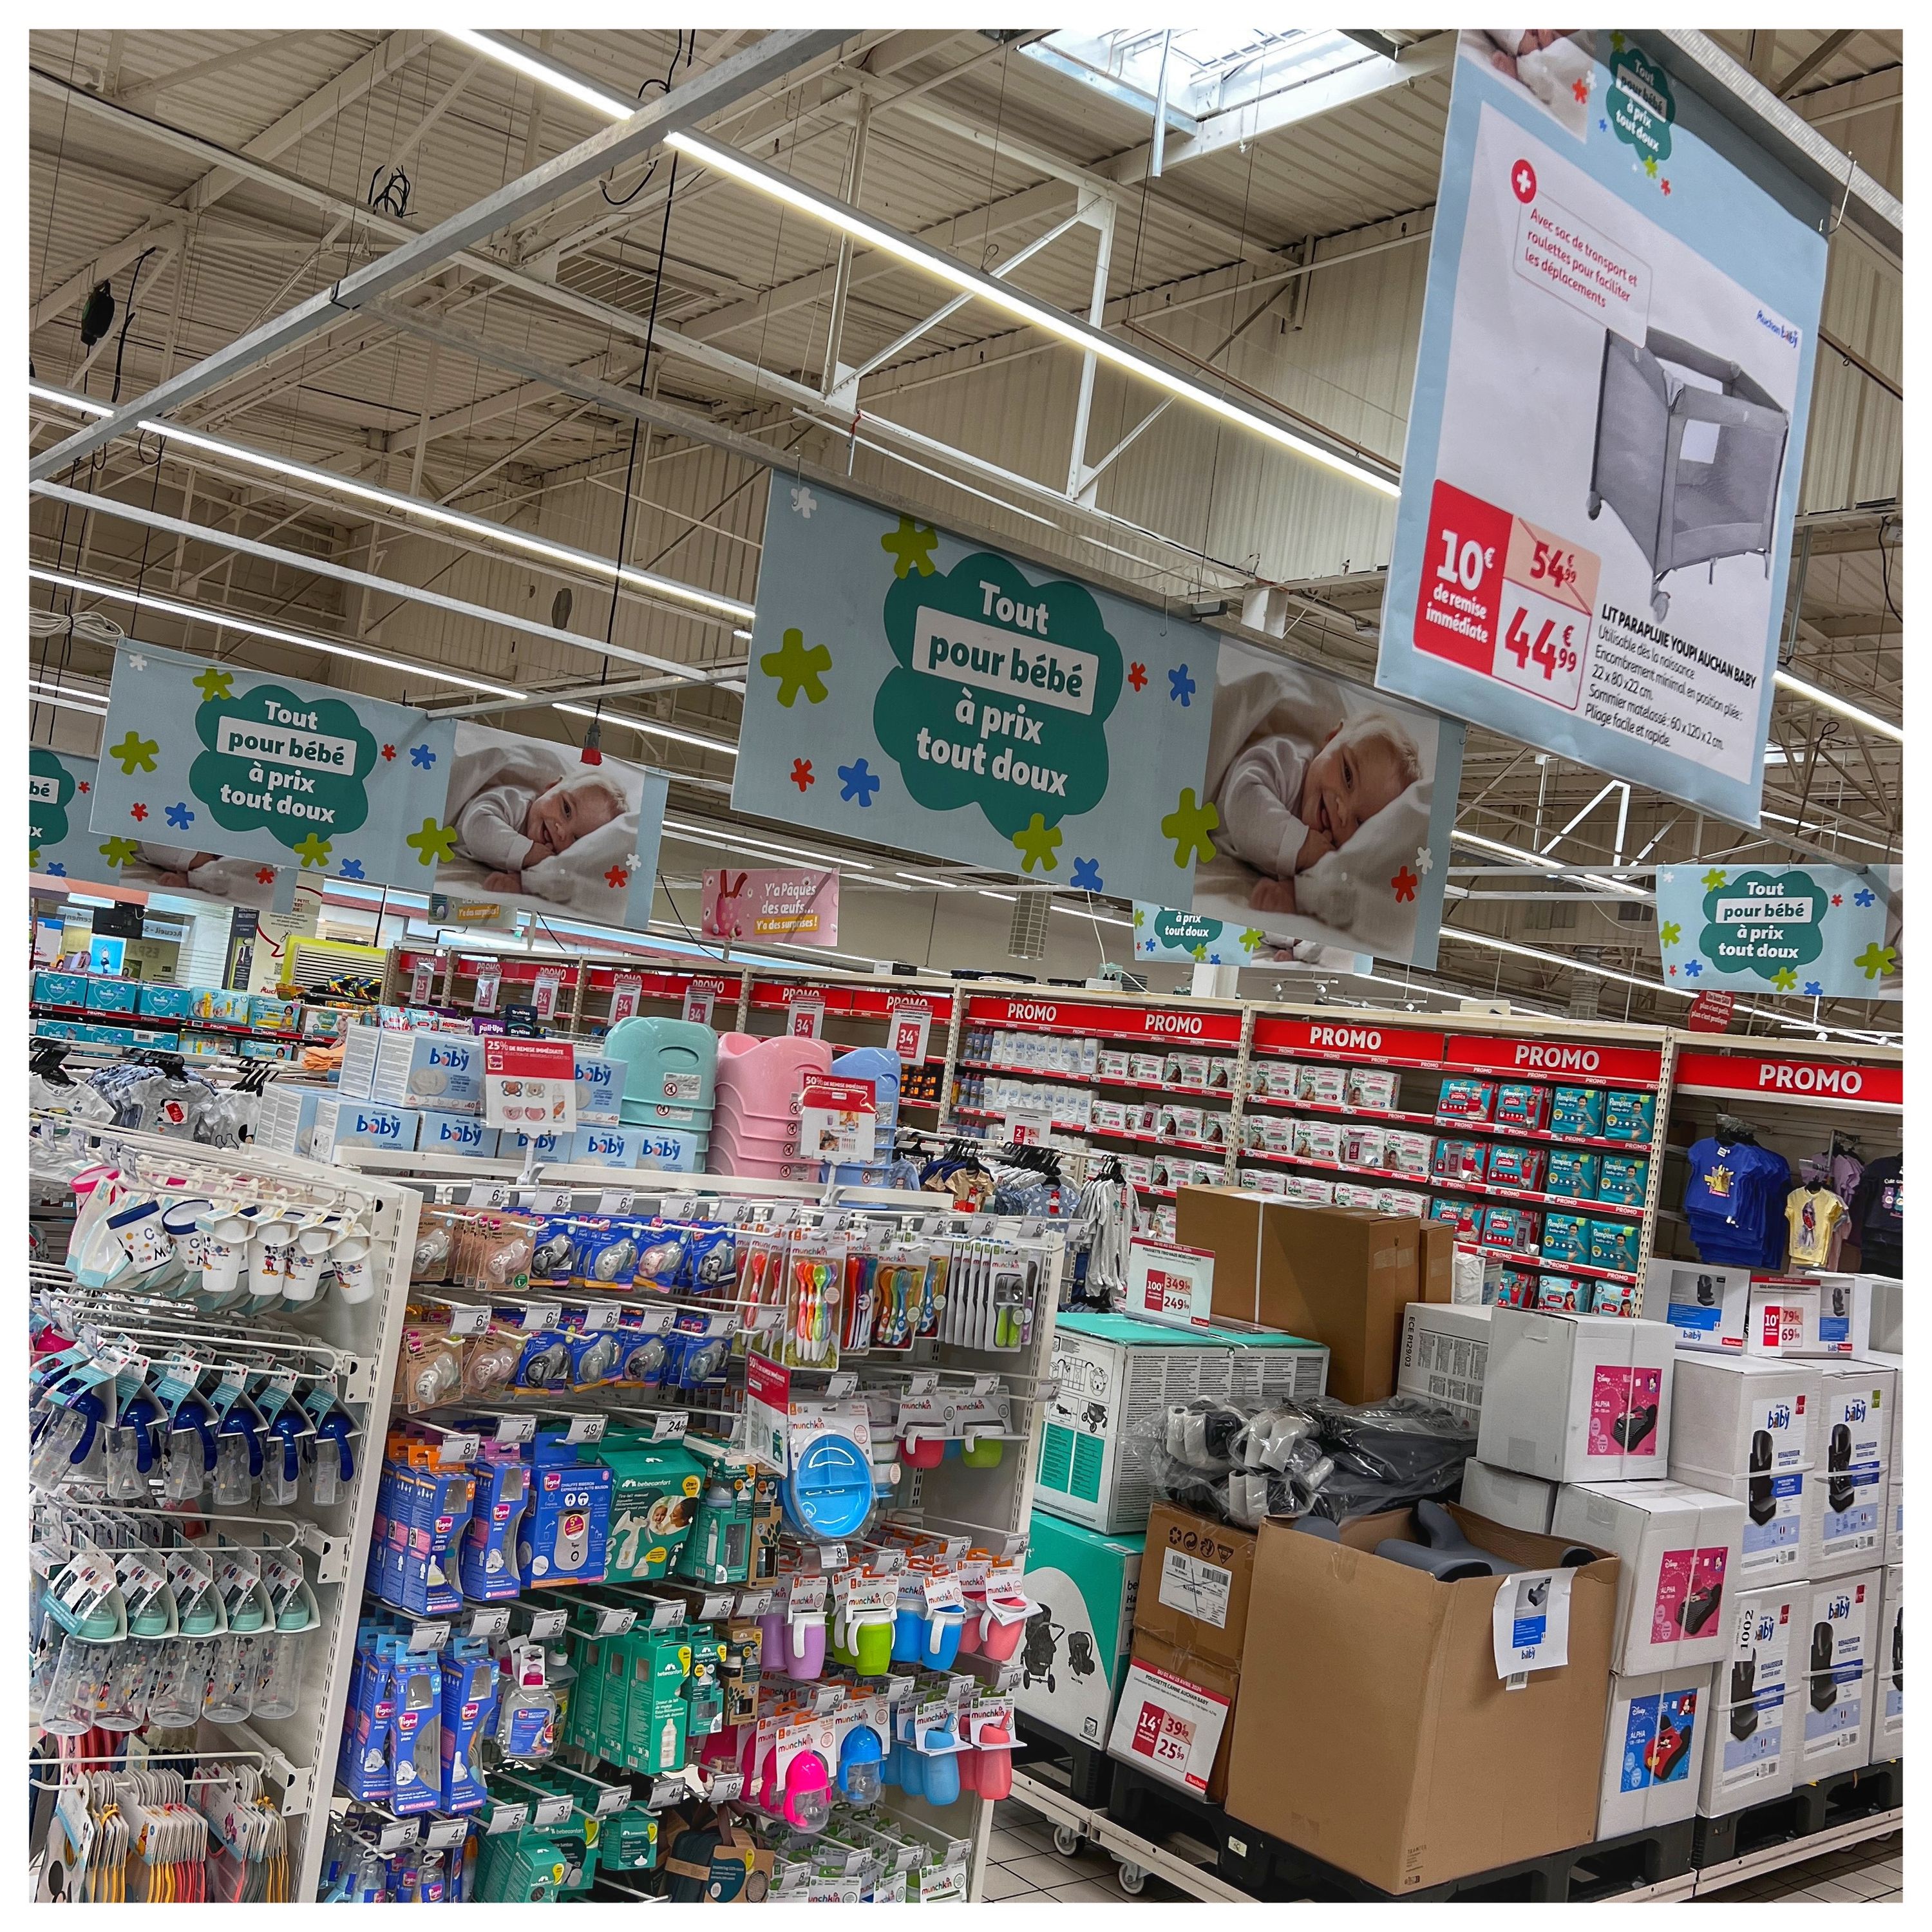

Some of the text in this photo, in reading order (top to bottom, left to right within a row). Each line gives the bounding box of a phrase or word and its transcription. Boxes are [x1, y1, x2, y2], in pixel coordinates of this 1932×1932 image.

[1634, 59, 1654, 86] Tout
[1616, 109, 1659, 152] tout doux
[1633, 107, 1652, 129] prix
[1530, 208, 1638, 287] Avec sac de transport et
[1525, 247, 1606, 307] les déplacements
[1528, 231, 1631, 302] roulettes pour faciliter
[979, 580, 1049, 635] Tout
[1433, 583, 1487, 620] de remise
[1425, 601, 1489, 643] immédiate
[1598, 625, 1695, 680] Utilisable dès la naissance
[1601, 603, 1757, 689] LIT PARAPLUIE YOUPI AUCHAN BABY
[928, 635, 1083, 697] pour bébé
[1592, 664, 1605, 681] 22
[1611, 672, 1622, 687] 80
[1595, 645, 1655, 682] Encombrement
[1655, 672, 1686, 695] minimal
[1687, 687, 1696, 699] en
[1696, 691, 1724, 712] position
[265, 700, 318, 730] Tout
[956, 687, 1044, 745] à prix
[1585, 703, 1612, 726] Pliage
[1613, 712, 1634, 734] facile
[1636, 725, 1644, 736] et
[1589, 684, 1627, 709] Sommier
[1671, 716, 1682, 732] 60
[1687, 723, 1701, 740] 120
[228, 732, 345, 766] pour bébé
[916, 727, 1068, 797] tout doux
[249, 761, 316, 793] à prix
[220, 784, 336, 824] tout doux
[765, 882, 817, 900] Y'a Pâques
[1747, 881, 1785, 896] Tout
[762, 900, 779, 914] des
[1175, 911, 1202, 925] à prix
[1723, 903, 1804, 921] pour bébé
[756, 920, 768, 931] Y'a
[768, 919, 781, 930] des
[781, 917, 813, 931] surprises
[1164, 925, 1209, 937] tout doux
[1737, 924, 1785, 942] à prix
[1718, 942, 1799, 959] tout doux
[1007, 1003, 1057, 1022] PROMO
[1144, 1014, 1203, 1034] PROMO
[488, 1041, 509, 1050] 25%
[1310, 1026, 1381, 1050] PROMO
[429, 1048, 469, 1072] baby
[1515, 1045, 1600, 1071] PROMO
[1759, 1064, 1862, 1094] PROMO
[356, 1114, 401, 1139] baby
[1625, 1142, 1647, 1151] PROMO
[792, 1244, 828, 1256] munchkin
[1405, 1334, 1414, 1367] R129/03
[1768, 1406, 1790, 1430] baby
[637, 1479, 671, 1488] bebeconfort
[849, 1593, 881, 1606] munchkin
[987, 1581, 1012, 1595] munchkin
[1740, 1610, 1754, 1650] 1002
[1145, 1674, 1168, 1687] POUSSETTE
[1180, 1688, 1197, 1700] AUCHAN
[1197, 1695, 1209, 1705] BABY
[1630, 1730, 1645, 1739] ALPHA
[1186, 1775, 1206, 1790] Auchan
